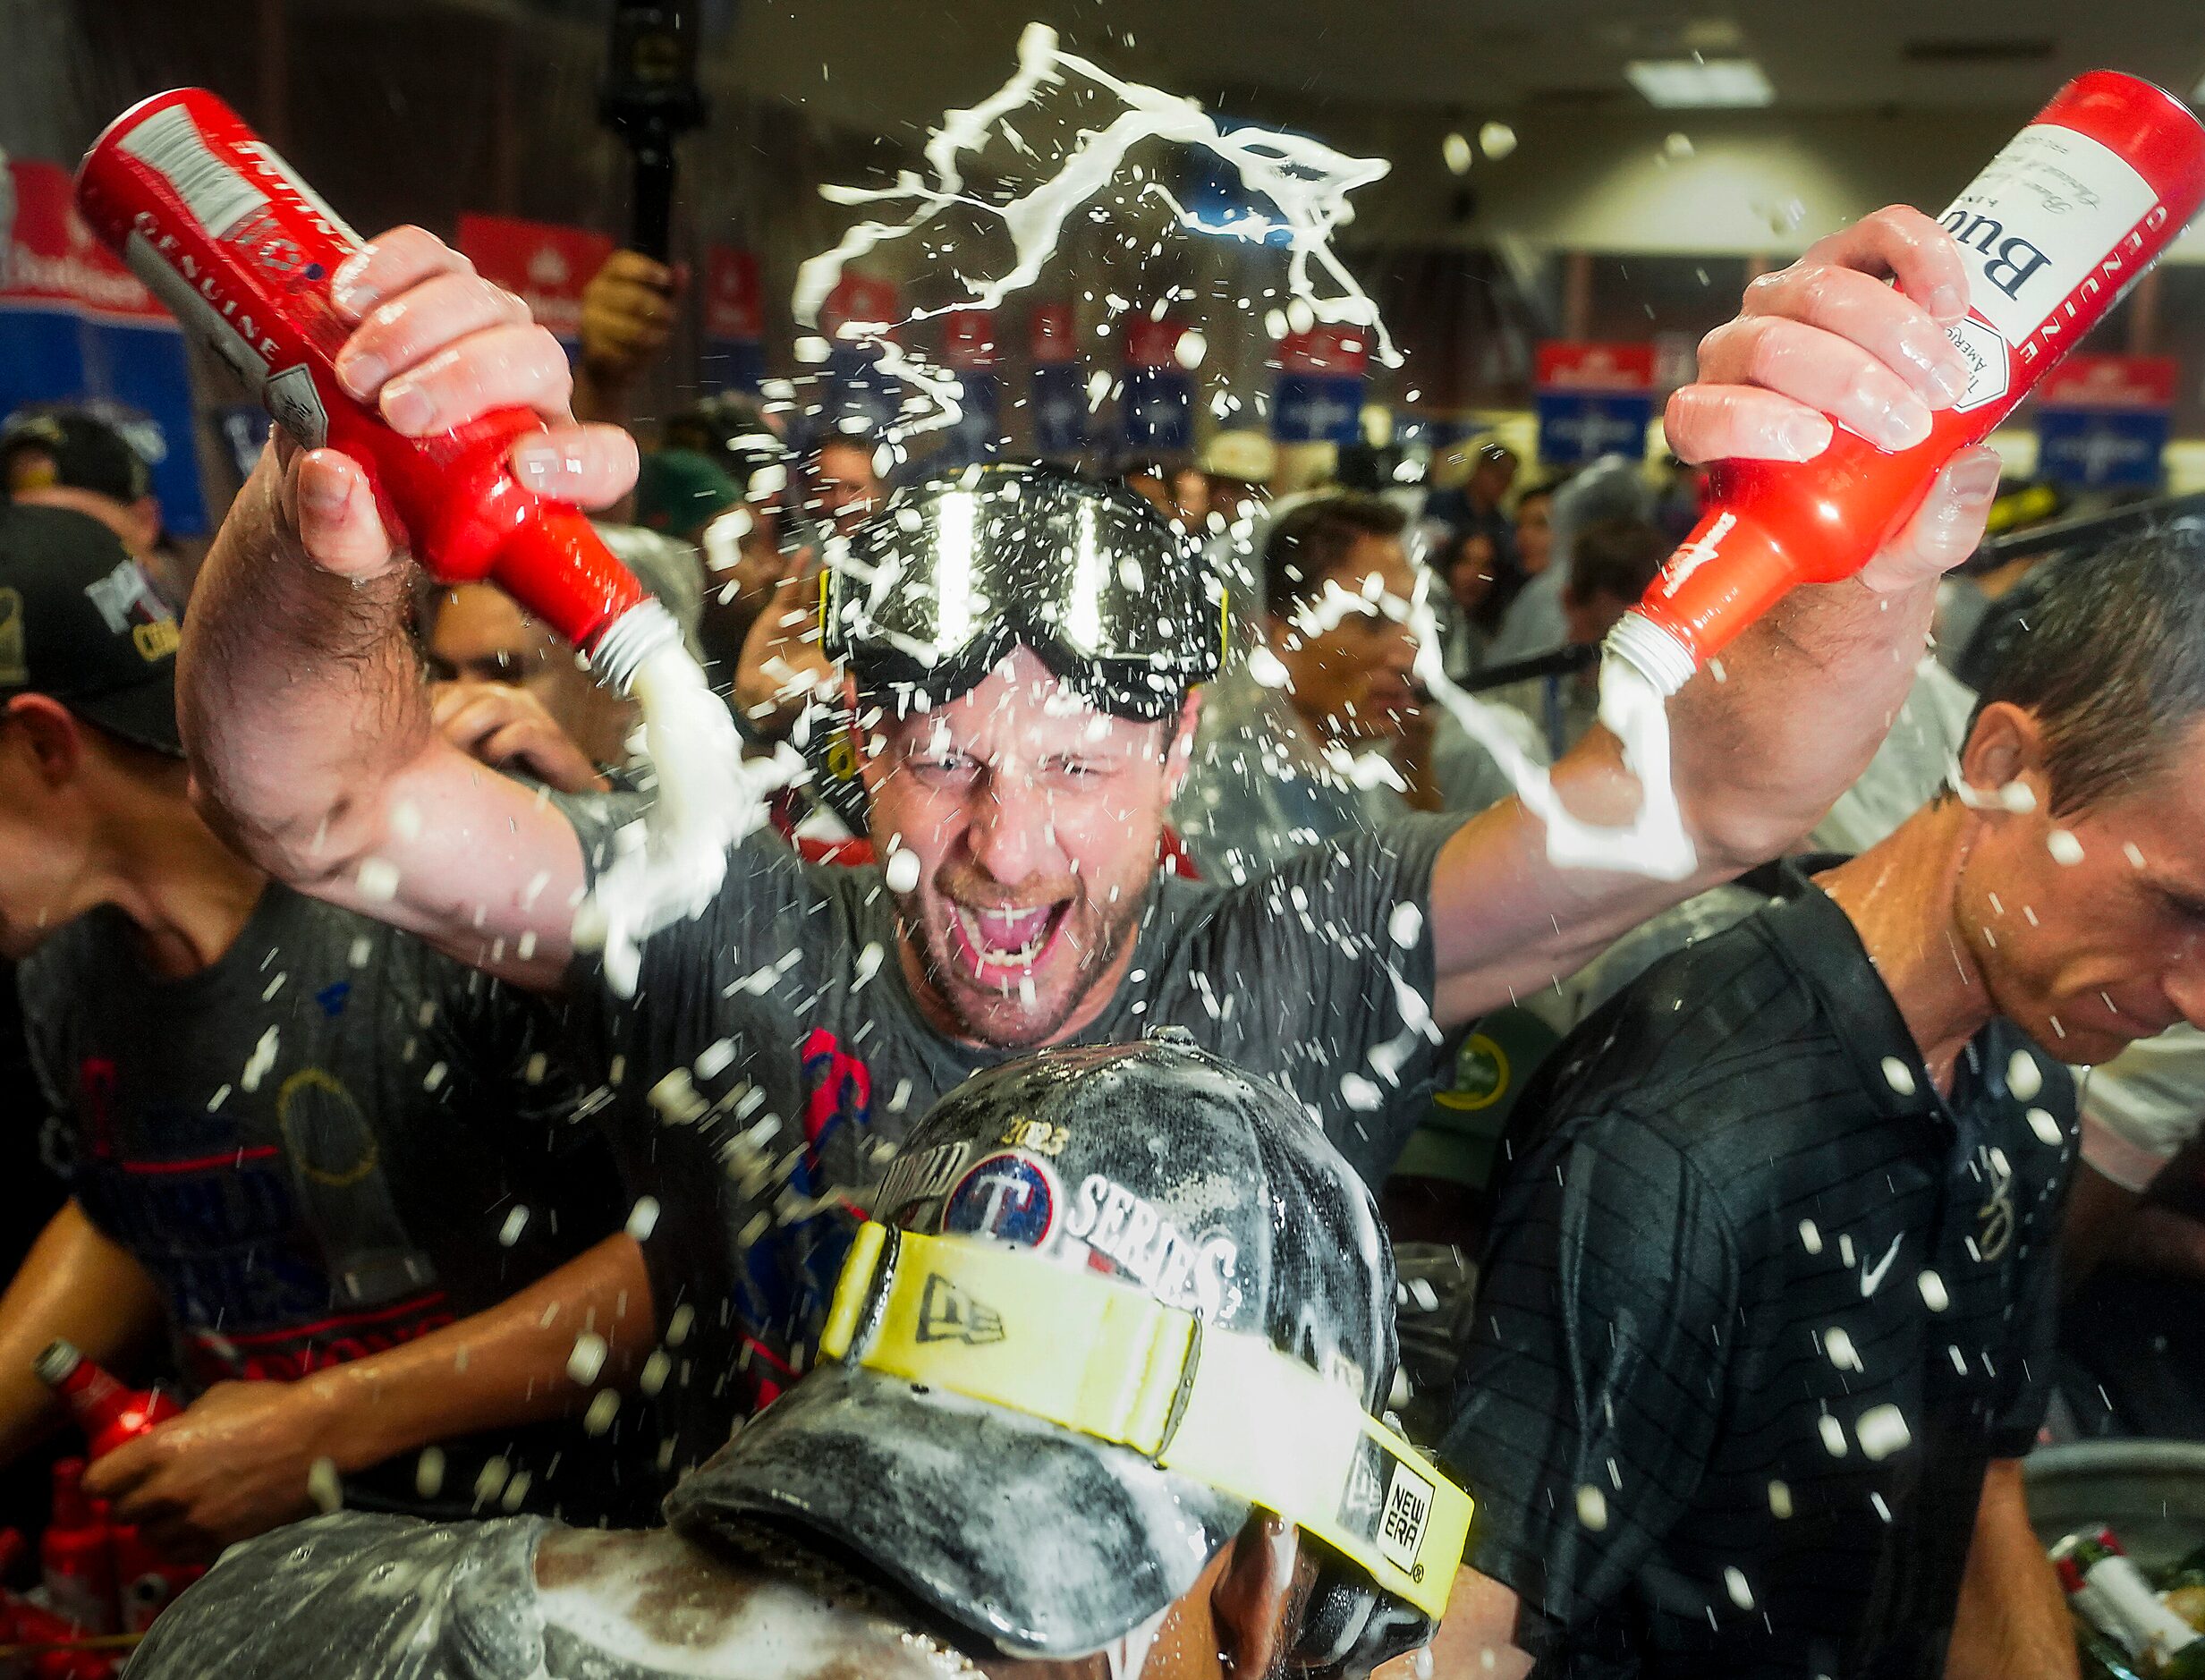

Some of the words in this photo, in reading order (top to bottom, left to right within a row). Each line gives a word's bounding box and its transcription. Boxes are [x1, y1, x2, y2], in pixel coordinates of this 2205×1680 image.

[133, 210, 279, 361] GENUINE
[2018, 206, 2167, 365] GENUINE
[1385, 1511, 1418, 1551] ERA
[1392, 1483, 1425, 1523] NEW
